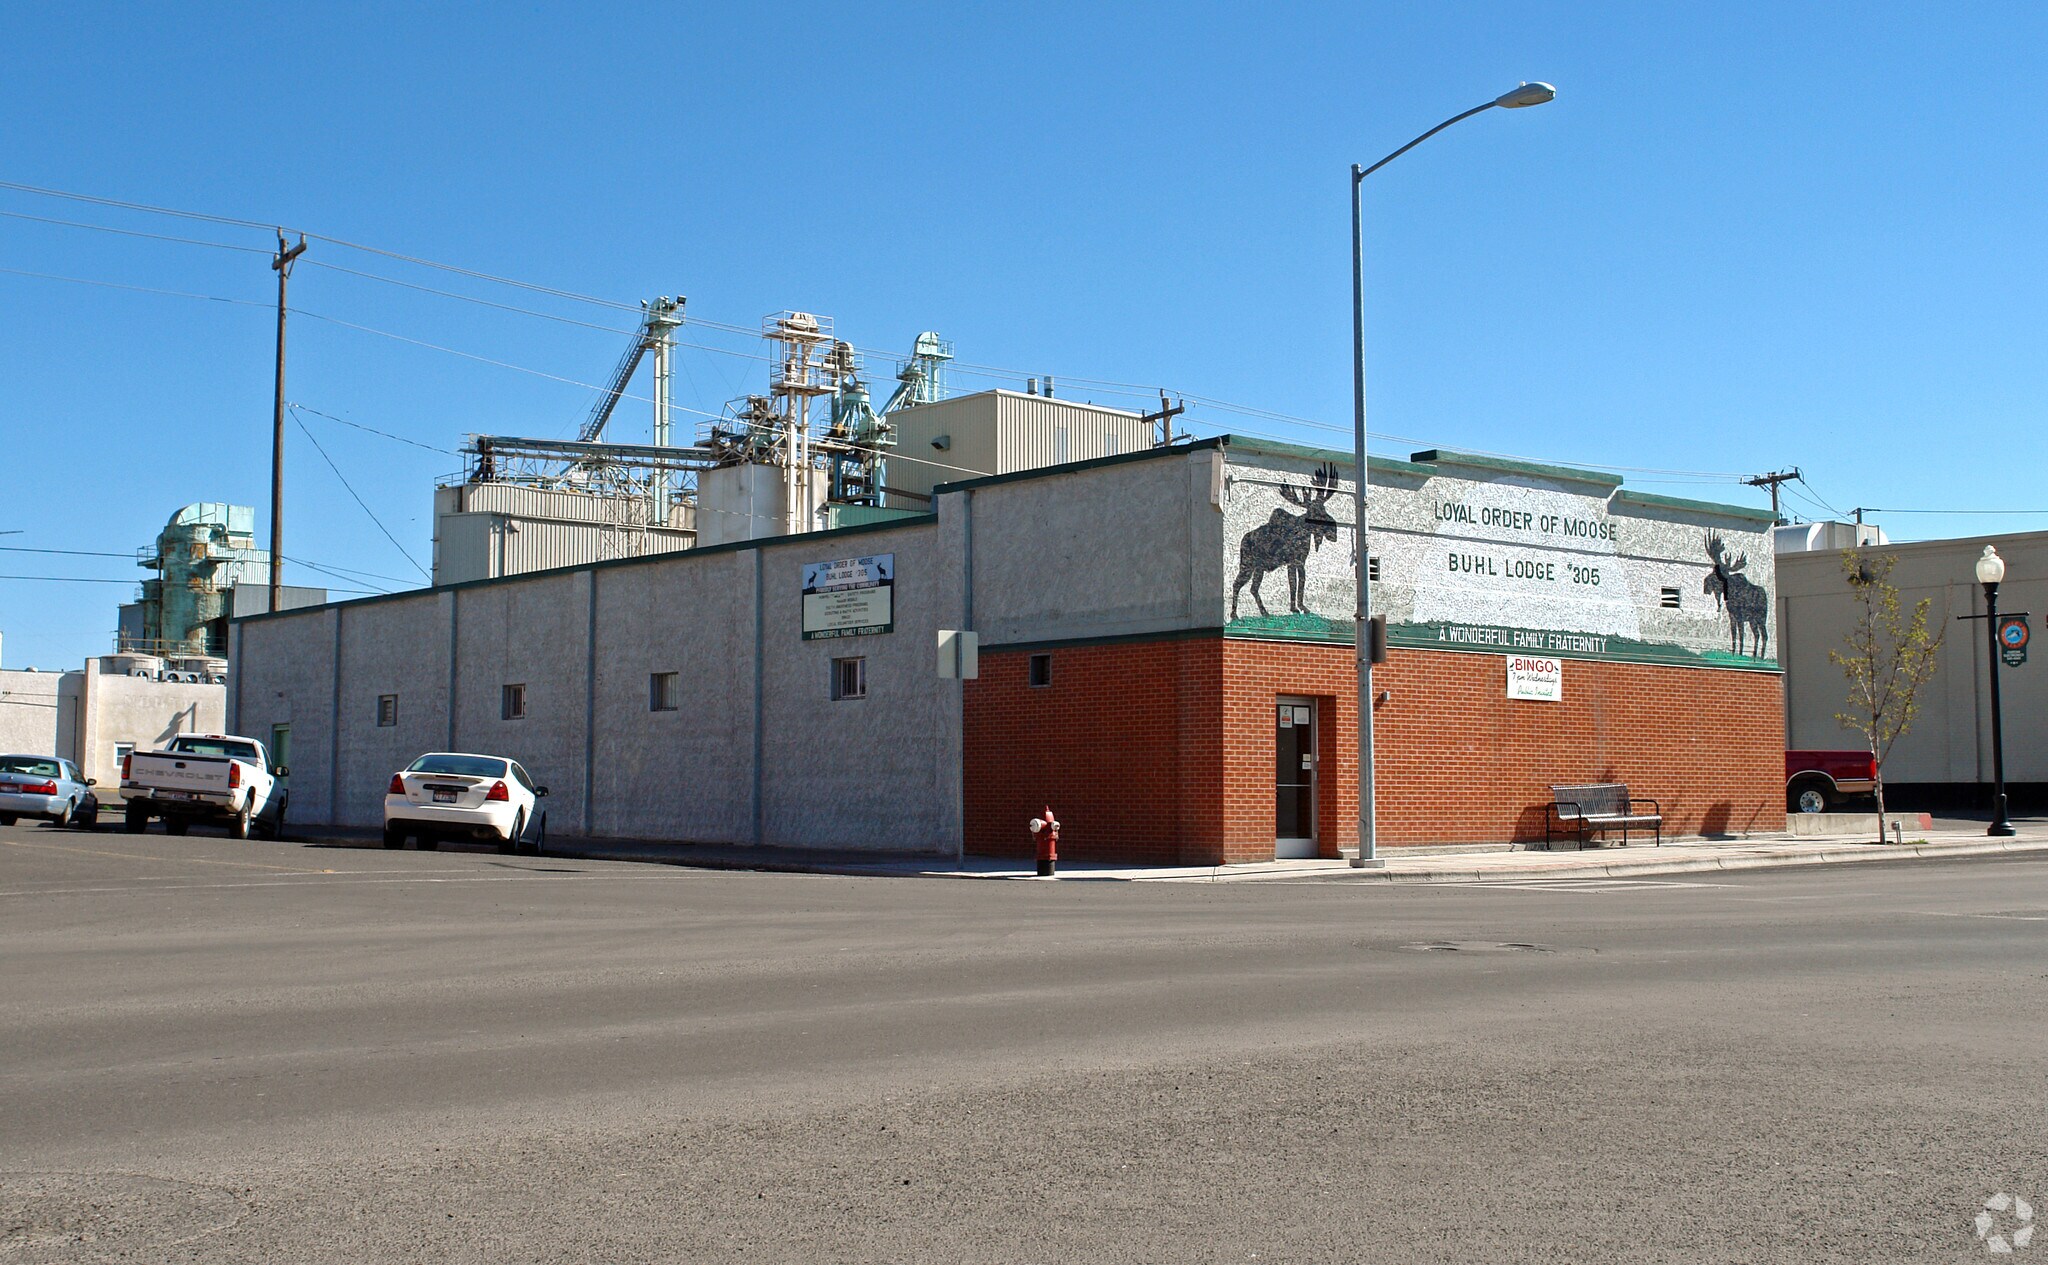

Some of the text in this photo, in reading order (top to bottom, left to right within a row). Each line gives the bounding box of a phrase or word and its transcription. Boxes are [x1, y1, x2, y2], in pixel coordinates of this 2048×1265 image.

[1434, 501, 1617, 541] LOYAL ORDER OF MOOSE
[1449, 553, 1497, 576] BUHL
[1506, 559, 1555, 581] LODGE
[1438, 626, 1607, 653] A WONDERFUL FAMILY FRATERNITY
[1515, 658, 1554, 673] BINGO
[135, 768, 224, 780] CHEVROLET
